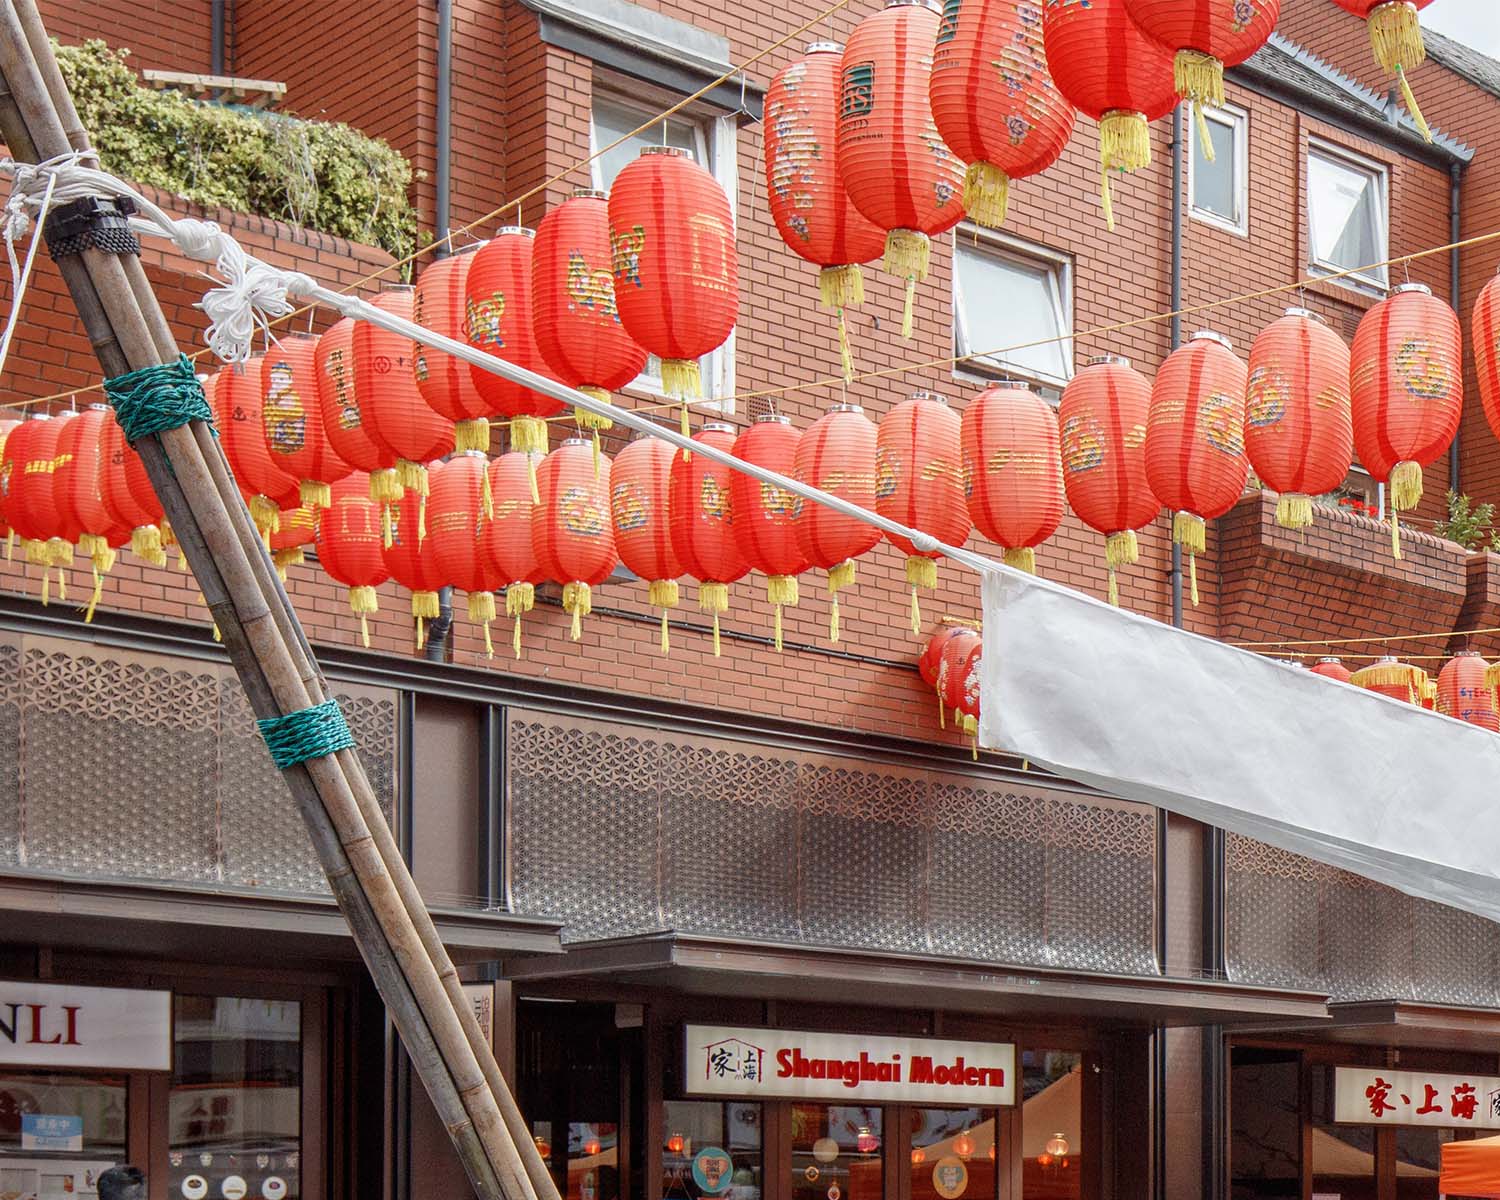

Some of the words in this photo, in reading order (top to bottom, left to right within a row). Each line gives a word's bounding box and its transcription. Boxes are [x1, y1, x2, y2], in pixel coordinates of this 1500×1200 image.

[710, 1047, 737, 1078] 家
[776, 1047, 901, 1088] Shanghai
[908, 1055, 1005, 1087] Modern
